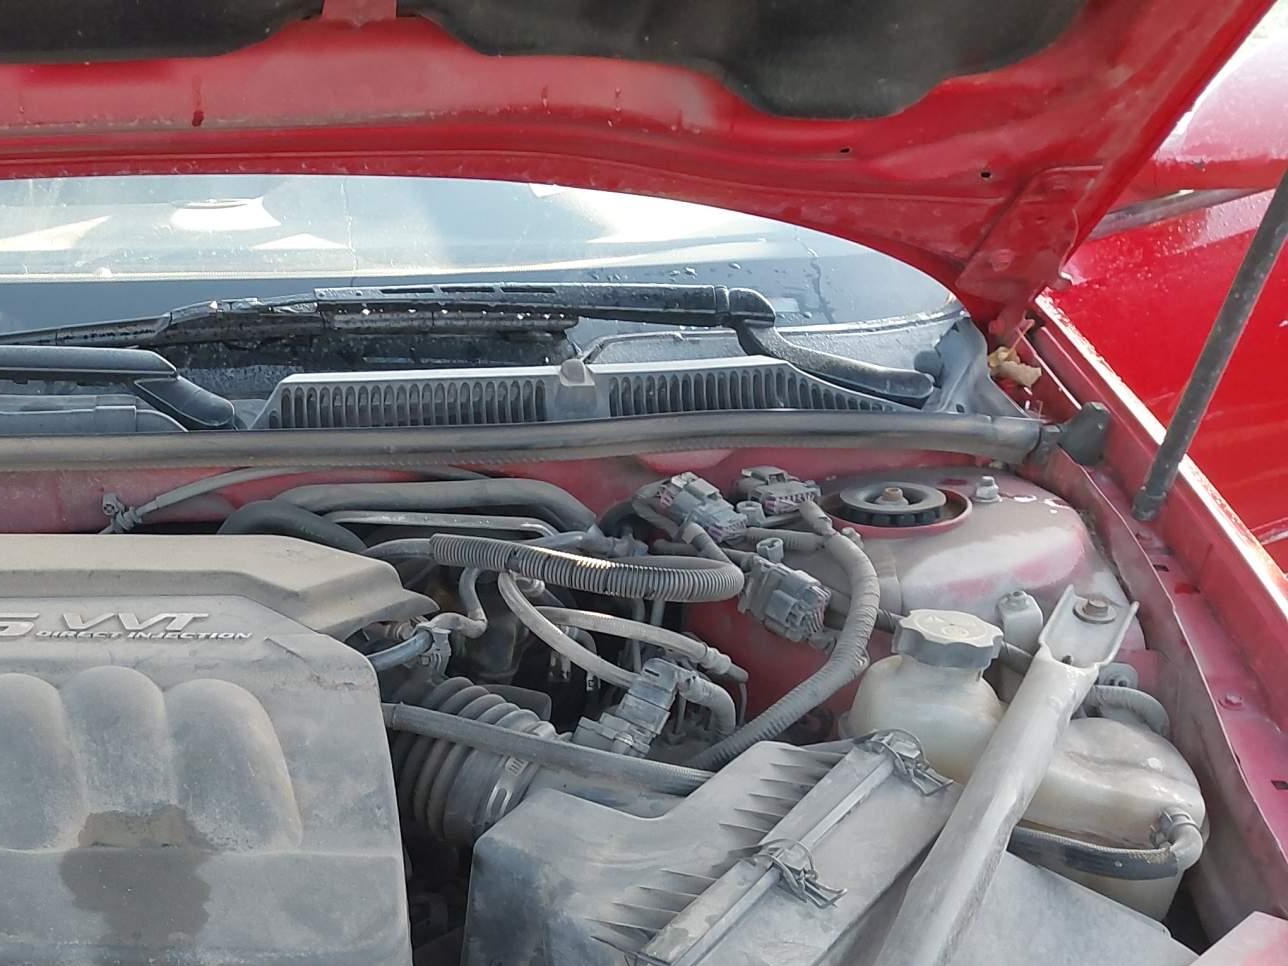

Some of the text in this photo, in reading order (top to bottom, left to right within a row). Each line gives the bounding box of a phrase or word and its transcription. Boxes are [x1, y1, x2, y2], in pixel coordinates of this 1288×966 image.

[63, 612, 209, 631] VVT
[36, 631, 253, 640] DIRECT INJECTION
